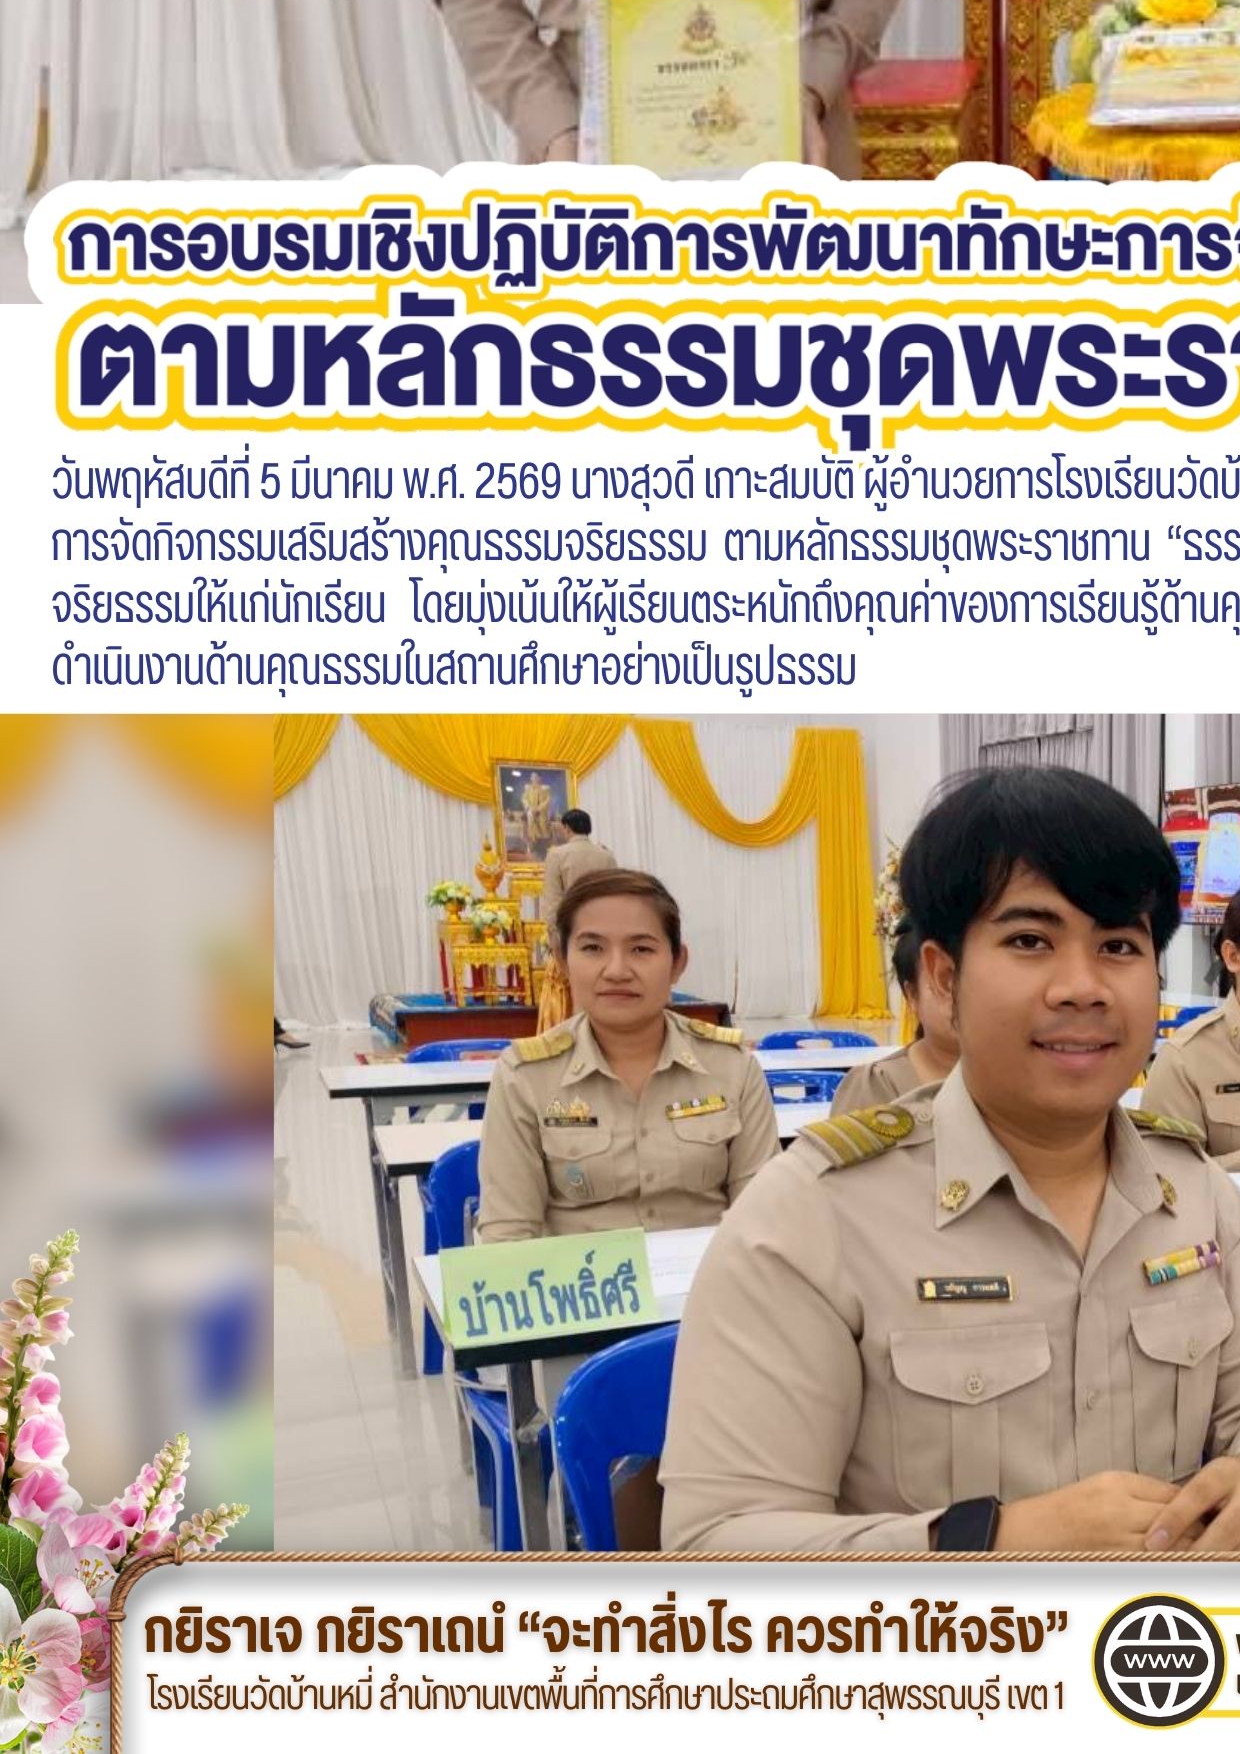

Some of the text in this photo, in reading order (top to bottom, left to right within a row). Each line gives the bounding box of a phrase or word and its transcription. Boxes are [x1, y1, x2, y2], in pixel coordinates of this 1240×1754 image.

[459, 1250, 640, 1338] บ้านโพธิ์ศรี
